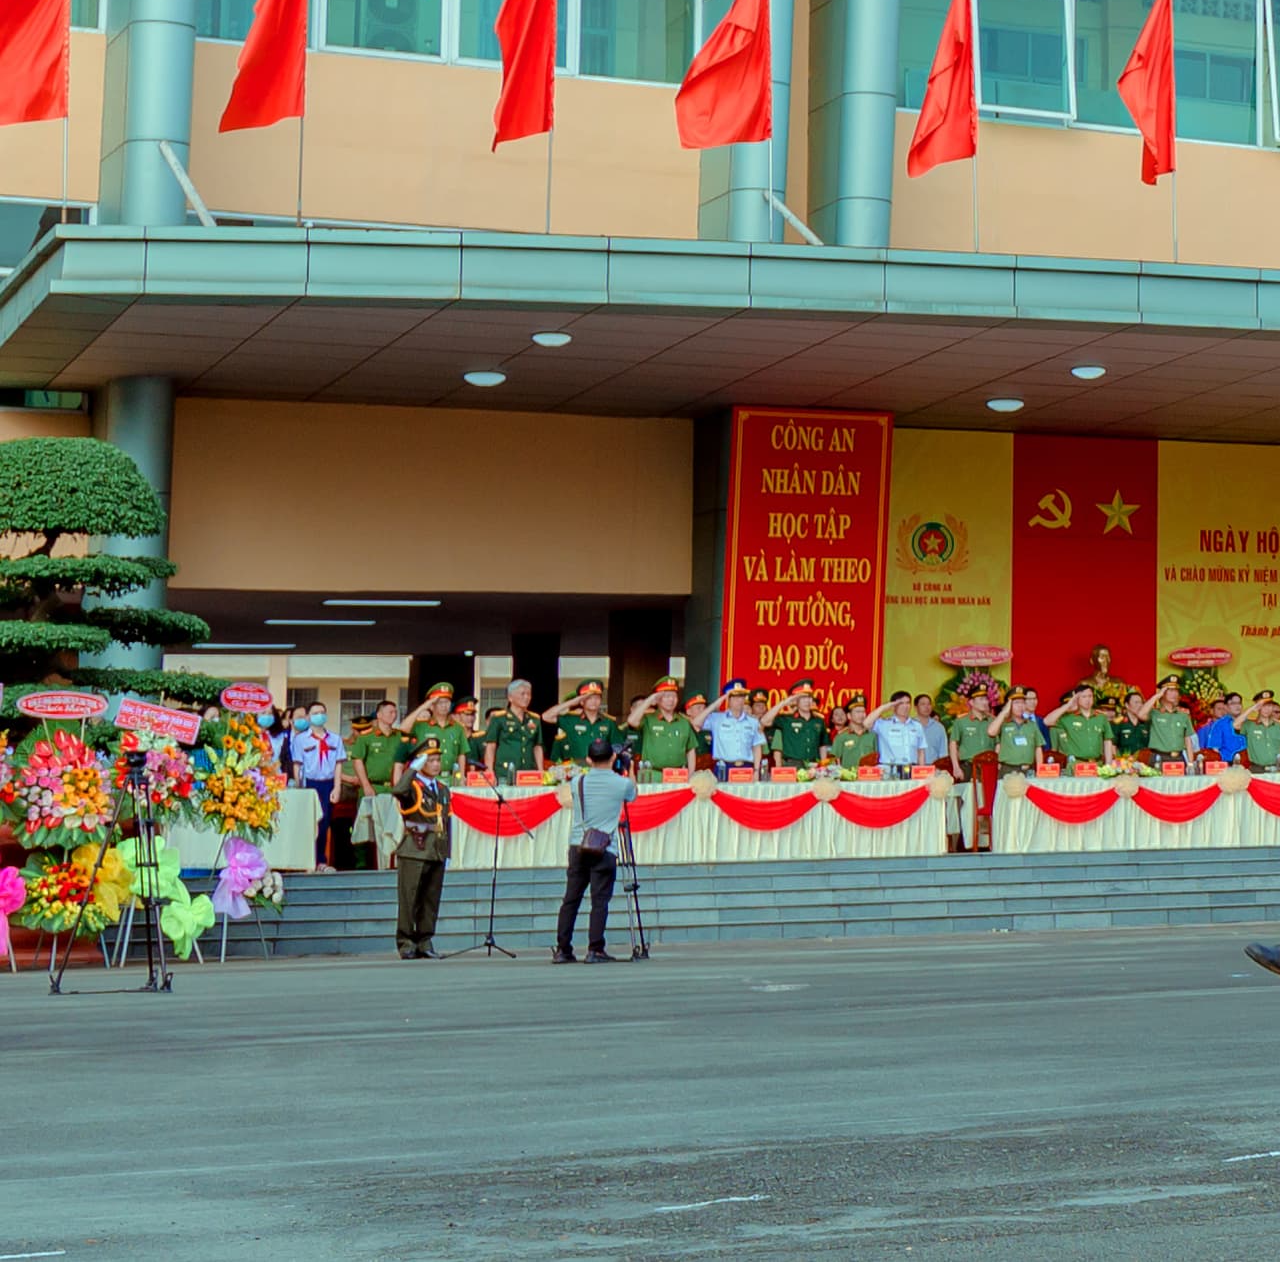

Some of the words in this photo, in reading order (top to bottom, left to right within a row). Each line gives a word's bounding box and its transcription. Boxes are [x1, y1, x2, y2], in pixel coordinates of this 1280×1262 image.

[771, 419, 824, 451] CÔNG
[828, 427, 856, 452] AN
[761, 462, 816, 495] NHÂN
[821, 464, 861, 495] DÂN
[768, 512, 809, 545] HỌC
[813, 506, 851, 545] TẬP
[1200, 524, 1249, 553] NGÀY
[743, 548, 768, 582] VÀ
[774, 549, 816, 582] LÀM
[820, 557, 872, 583] THEO
[1164, 563, 1176, 581] VÀ
[1180, 565, 1205, 582] CHÀO
[1208, 564, 1236, 582] MỪNG
[1239, 563, 1250, 582] KỶ
[1254, 566, 1278, 586] NIỆM
[755, 595, 783, 626] TƯ
[786, 590, 855, 632] TƯỞNG,
[1262, 593, 1277, 610] TẠI
[758, 644, 800, 676] ĐẠO
[804, 637, 848, 675] ĐỨC,
